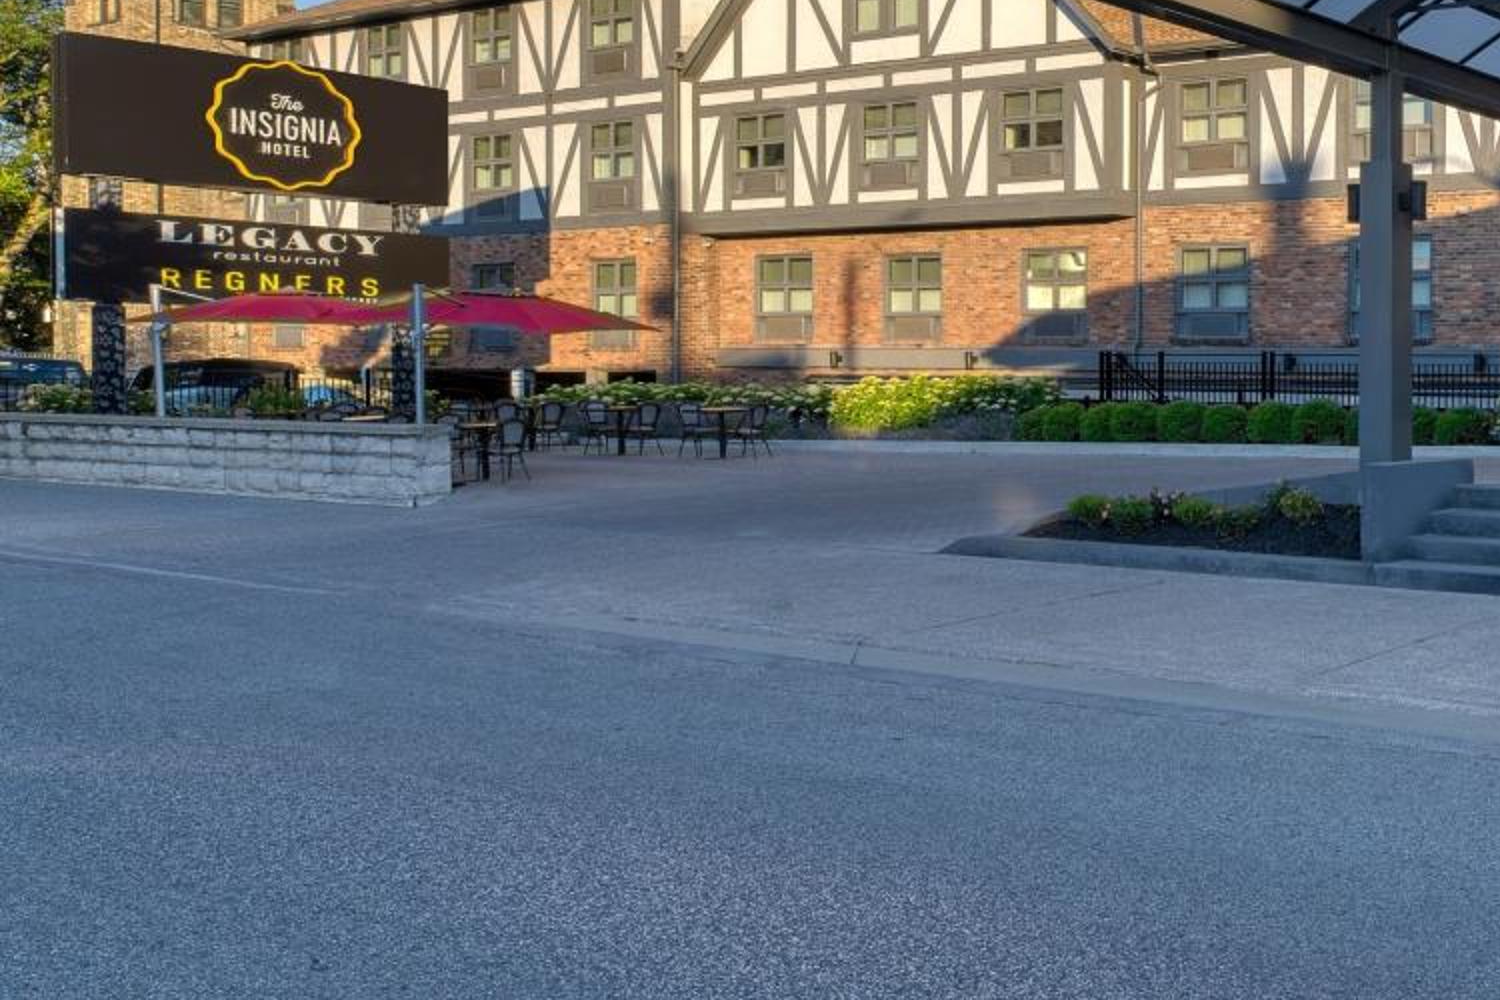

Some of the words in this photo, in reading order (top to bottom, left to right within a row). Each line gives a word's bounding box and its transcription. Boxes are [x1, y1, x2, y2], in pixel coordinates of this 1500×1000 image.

[271, 93, 303, 111] The
[230, 107, 341, 146] INSIGNIA
[261, 142, 310, 158] HOTEL
[156, 220, 383, 256] LEGACY
[213, 251, 340, 266] restaurant
